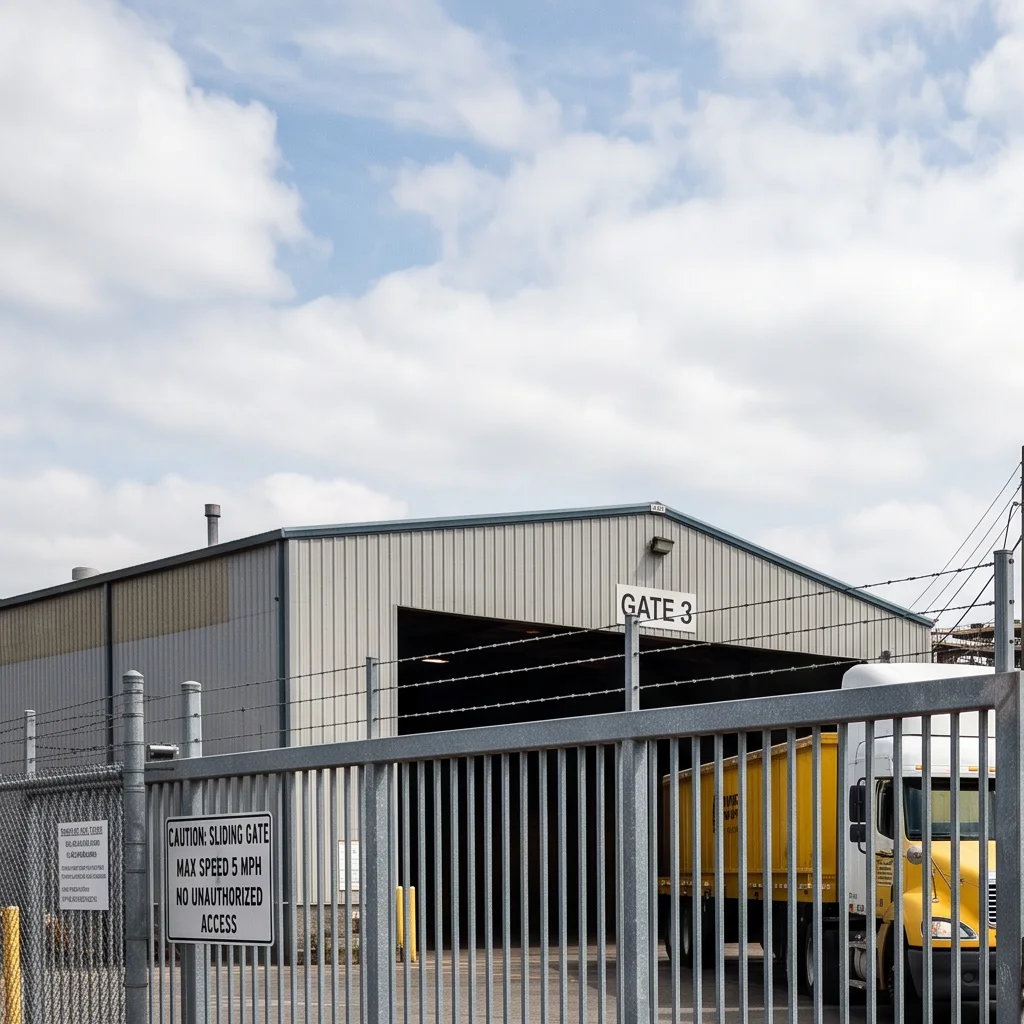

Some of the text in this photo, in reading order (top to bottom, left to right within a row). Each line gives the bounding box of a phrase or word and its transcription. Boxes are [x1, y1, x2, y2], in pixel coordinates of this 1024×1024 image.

[621, 593, 692, 625] GATE 3
[168, 822, 270, 847] CAUTION: SLIDING GATE
[176, 856, 262, 877] MAX SPEED 5 MPH
[176, 886, 263, 906] NO UNAUTHORIZED
[200, 914, 238, 934] ACCESS
